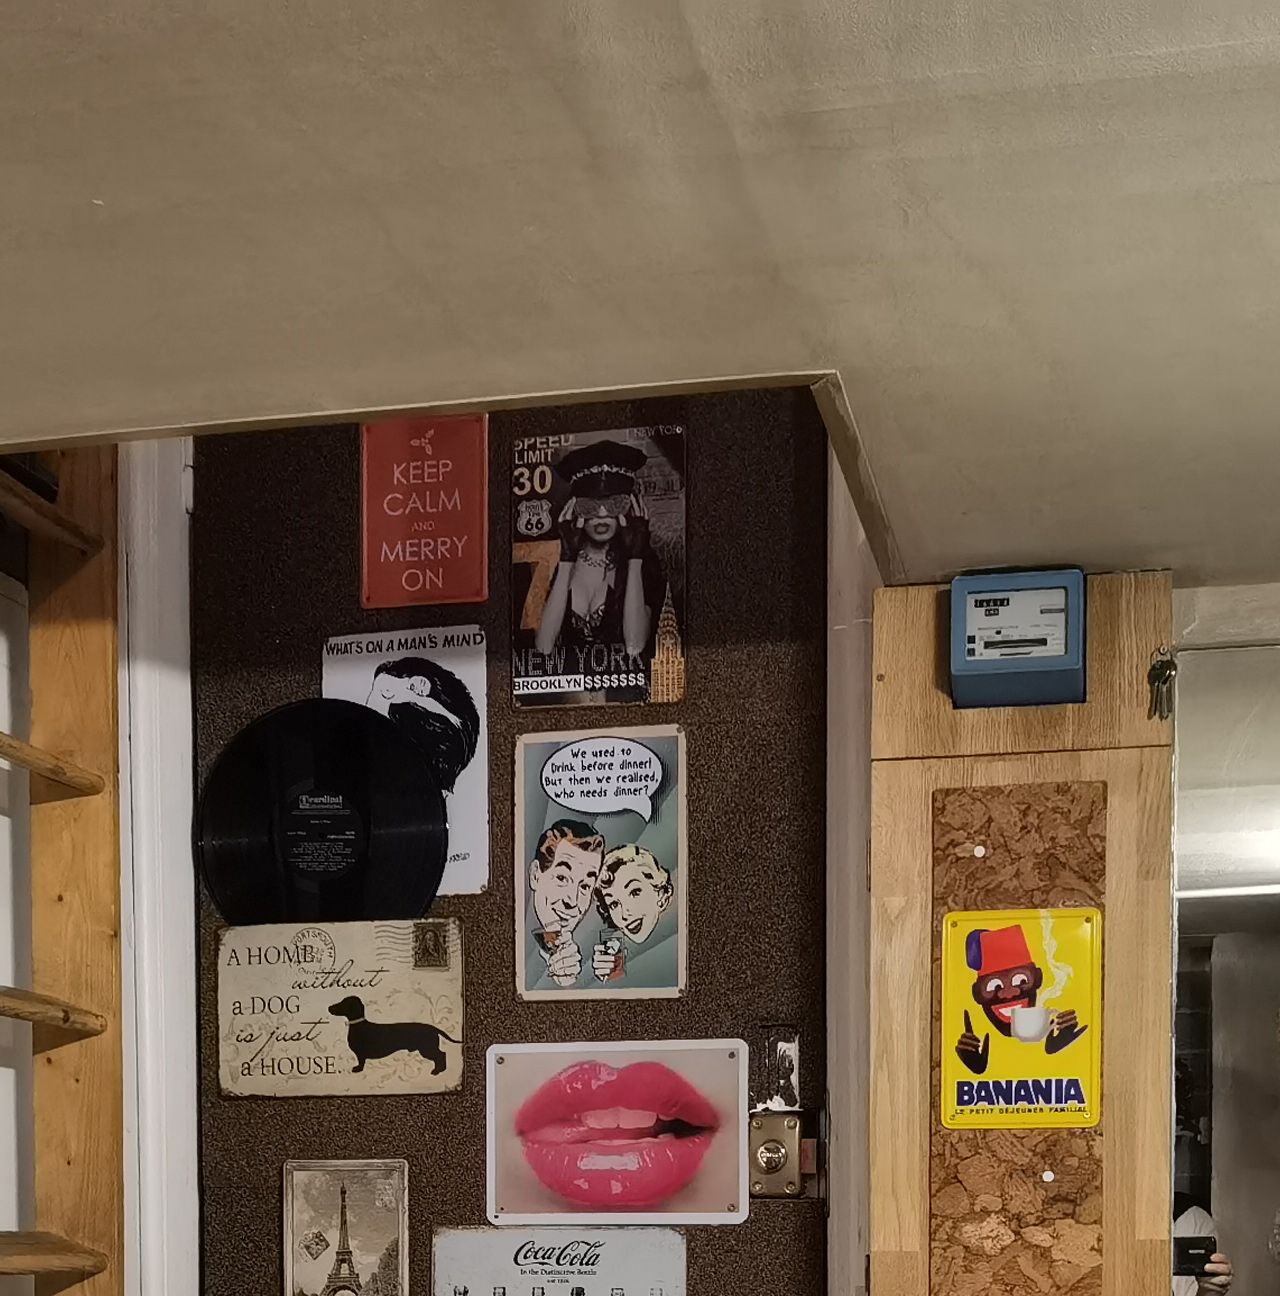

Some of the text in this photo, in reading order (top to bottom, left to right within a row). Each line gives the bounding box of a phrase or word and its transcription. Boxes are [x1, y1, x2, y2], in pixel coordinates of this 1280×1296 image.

[514, 434, 573, 450] SPEED
[515, 450, 554, 465] LIMIT
[393, 460, 453, 486] KEEP
[512, 464, 553, 496] 30
[383, 488, 461, 516] CALM
[411, 520, 435, 532] AND
[524, 517, 545, 532] 66
[380, 536, 468, 563] MERRY
[401, 568, 443, 592] ON
[366, 639, 383, 654] ON
[386, 638, 394, 652] A
[397, 633, 438, 651] MAN'S
[442, 633, 484, 648] MIND
[513, 676, 583, 692] BROOKLYN
[571, 747, 632, 759] We used to
[551, 762, 576, 773] Drink
[581, 760, 614, 773] before
[544, 776, 562, 787] But
[568, 774, 591, 785] then
[596, 775, 611, 784] we
[554, 784, 649, 799] who needs dinner?
[227, 949, 241, 966] A
[291, 959, 390, 990] without
[232, 996, 300, 1016] a DOG
[236, 1017, 330, 1062] is just
[241, 1061, 253, 1077] a
[956, 1078, 1086, 1106] BANANIA
